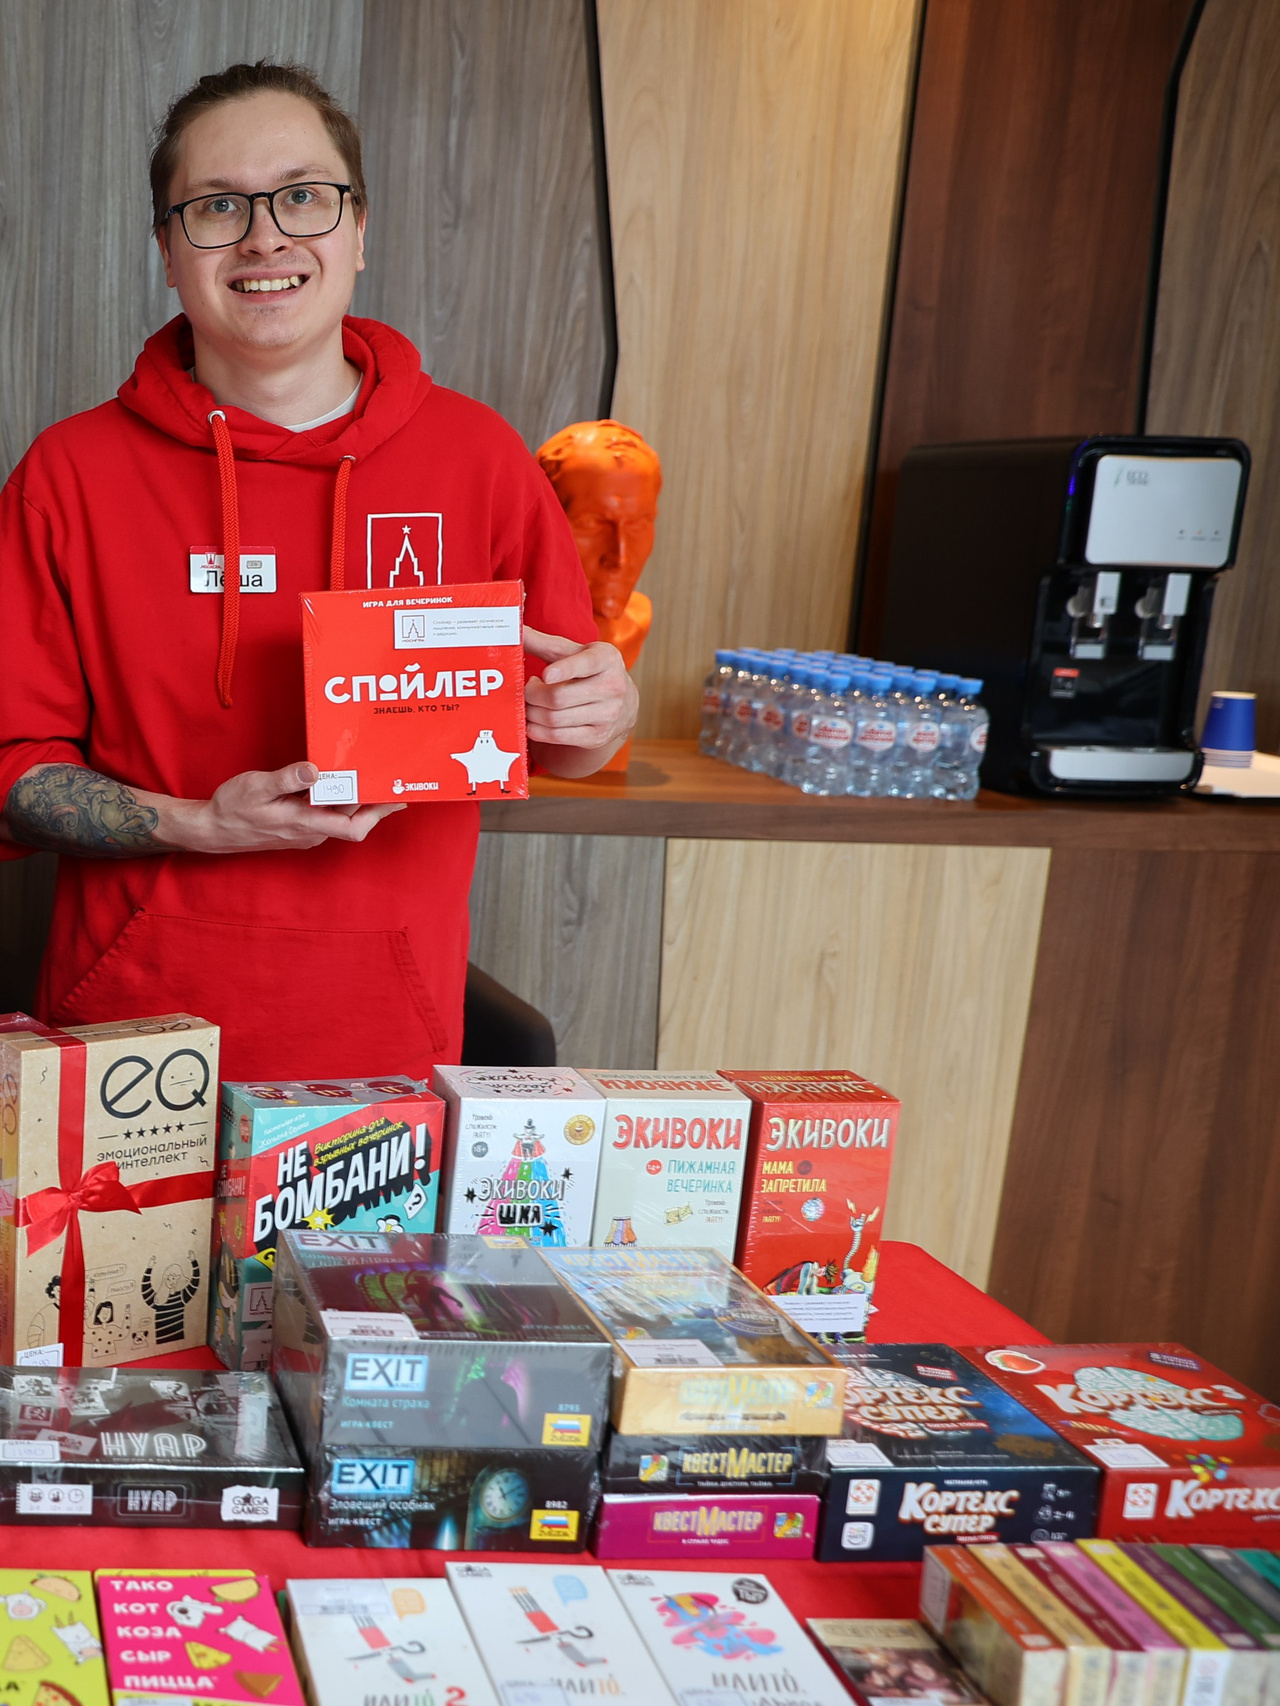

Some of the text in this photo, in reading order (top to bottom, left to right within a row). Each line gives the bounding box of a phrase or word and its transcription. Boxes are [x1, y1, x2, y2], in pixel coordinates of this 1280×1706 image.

[406, 597, 453, 606] ВЕЧЕРИНОК
[324, 662, 505, 704] СПОЙЛЕР
[596, 1078, 732, 1091] ЭКИВОКИ
[314, 1117, 386, 1155] Викторина для
[612, 1114, 743, 1150] ЭКИВОКИ
[765, 1117, 891, 1152] ЭКИВОКИ
[96, 1133, 208, 1163] эмоциональный
[313, 1121, 404, 1167] взрывных вечеринок
[117, 1151, 189, 1171] интеллект
[277, 1141, 308, 1186] НЕ
[667, 1159, 736, 1174] ПИЖАМНАЯ
[762, 1161, 794, 1174] МАМА
[253, 1123, 427, 1242] БОМБАНИ!
[477, 1178, 565, 1201] ЭКИВОКИ
[666, 1179, 733, 1193] ВЕЧЕРИНКА
[760, 1179, 827, 1193] ЗАПРЕТИЛА
[299, 1233, 380, 1250] EXIT
[350, 1358, 422, 1387] EXIT
[341, 1396, 430, 1409] Комната страха
[845, 1386, 983, 1408] ОРТЕКС
[1034, 1384, 1247, 1415] КОРТЕКС 3
[858, 1404, 966, 1422] СУПЕР
[340, 1420, 394, 1429] ИГРА-КВЕСТ
[100, 1432, 207, 1458] НУАР
[337, 1463, 409, 1490] EXIT
[127, 1489, 178, 1512] НУАР
[329, 1500, 436, 1513] Зловещий особняк
[545, 1501, 567, 1509] 8982
[898, 1482, 1020, 1524] КОРТЕКС
[231, 1505, 269, 1515] GAMES
[328, 1518, 381, 1526] ИГРА-КВЕСТ
[924, 1514, 996, 1534] СУПЕР
[110, 1580, 174, 1592] ТАКО
[113, 1603, 160, 1614] КОТ
[117, 1626, 182, 1638] КОЗА
[120, 1650, 171, 1662] СЫР
[123, 1675, 214, 1689] ПИЦЦА
